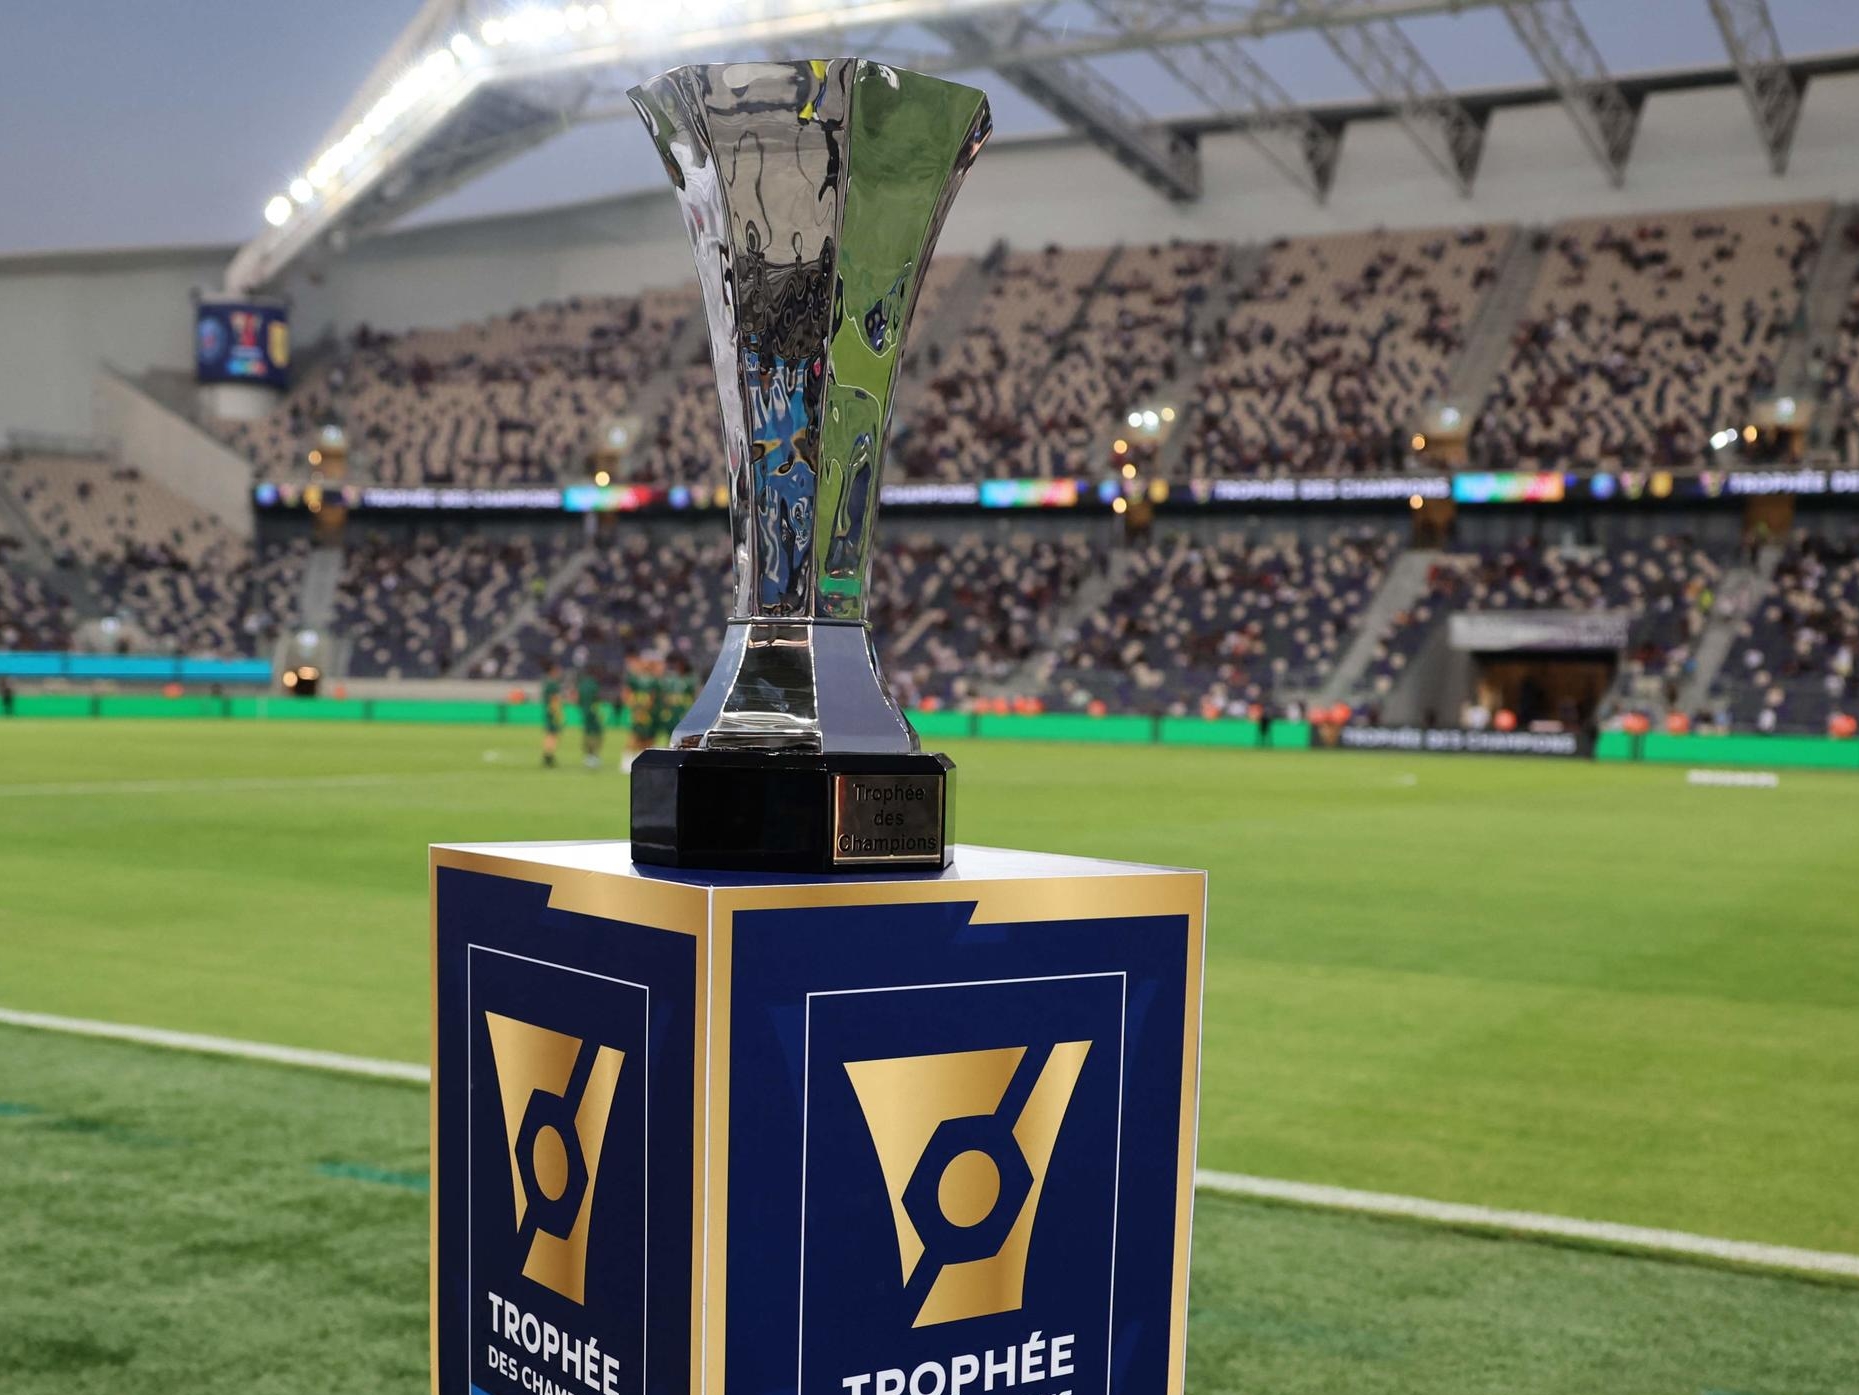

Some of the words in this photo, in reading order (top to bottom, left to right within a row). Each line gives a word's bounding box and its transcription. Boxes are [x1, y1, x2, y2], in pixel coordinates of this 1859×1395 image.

[1831, 469, 1859, 493] DE
[852, 783, 925, 806] Trophée
[873, 809, 905, 826] des
[837, 832, 937, 856] Champions
[488, 1290, 620, 1395] TROPHÉE
[488, 1344, 518, 1381] DES
